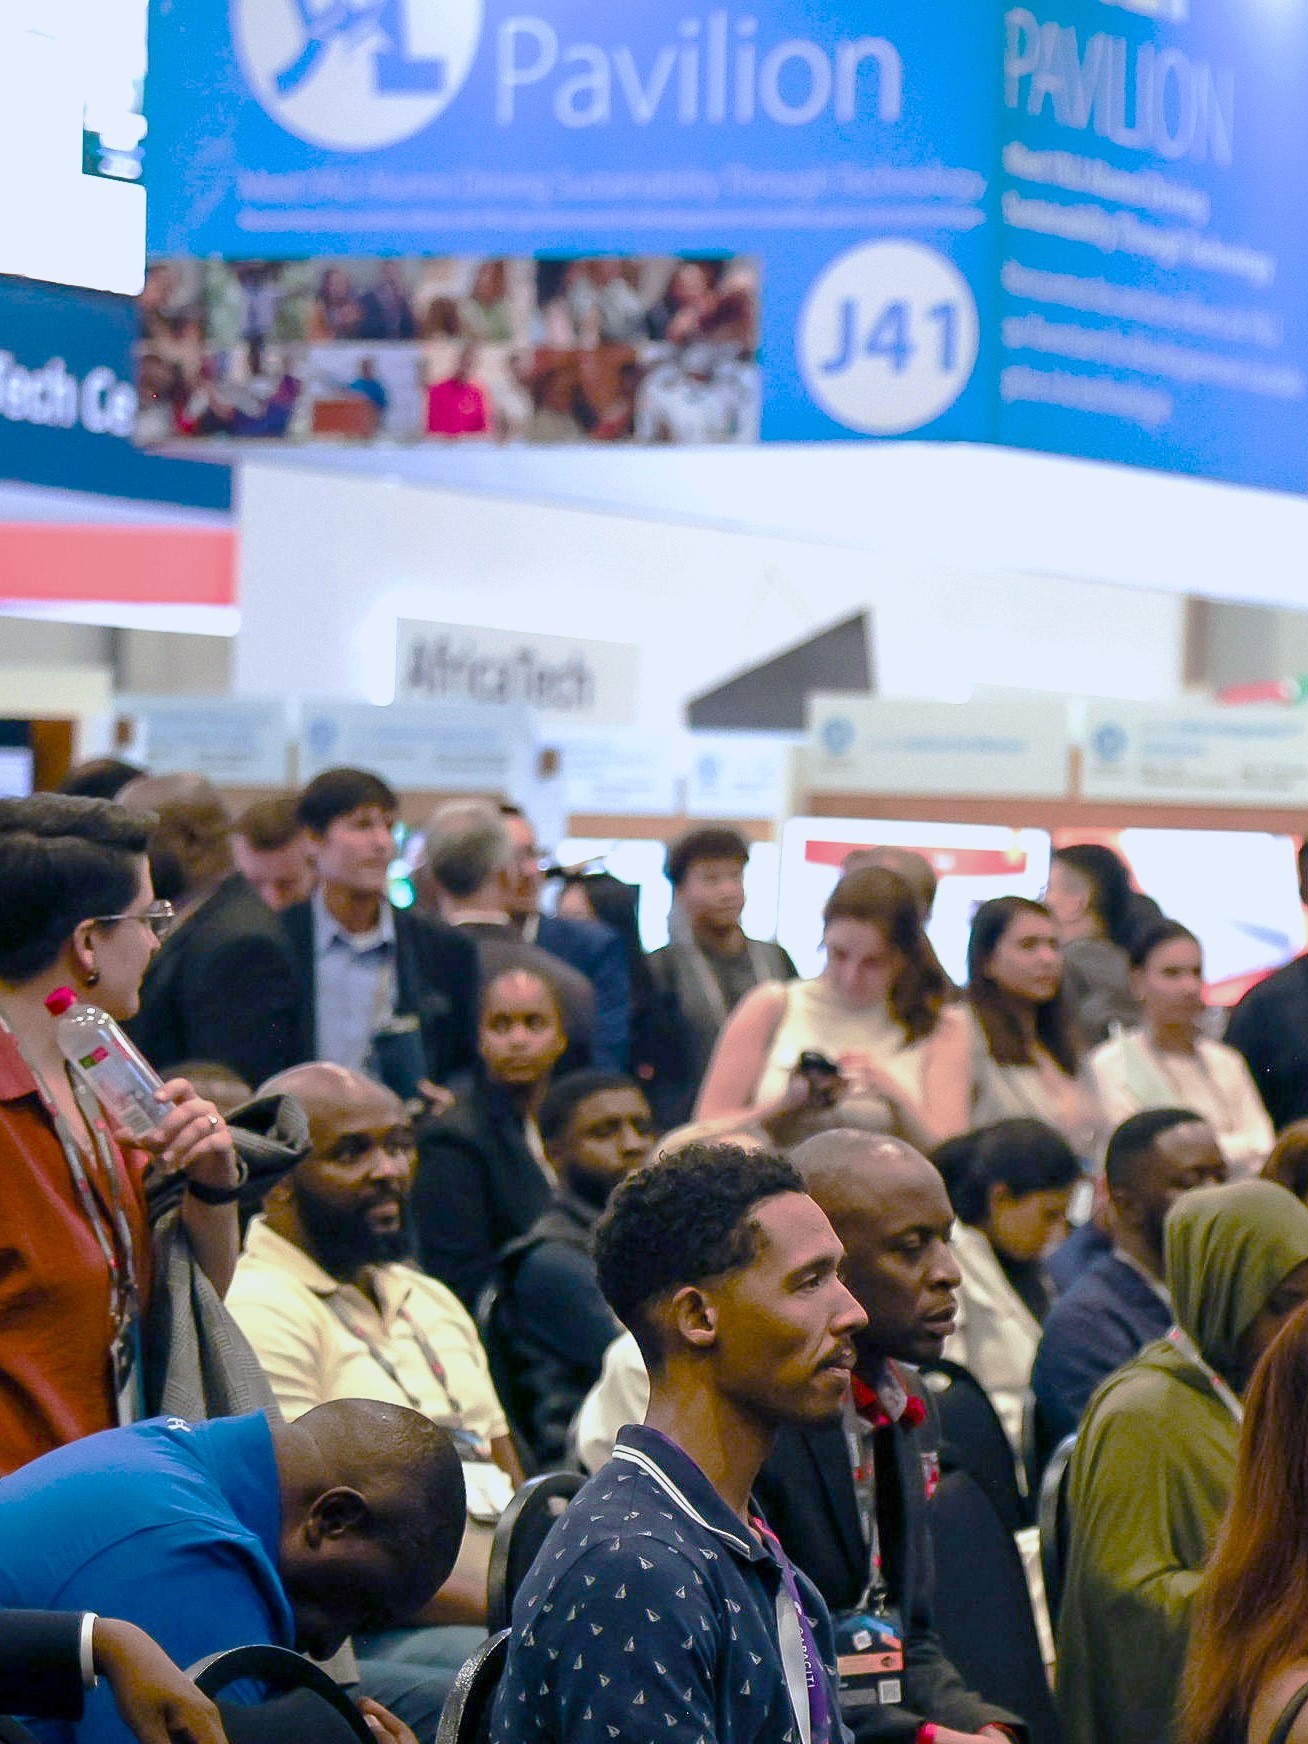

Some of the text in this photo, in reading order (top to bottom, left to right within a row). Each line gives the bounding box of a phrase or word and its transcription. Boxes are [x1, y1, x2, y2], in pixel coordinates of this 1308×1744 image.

[495, 9, 903, 128] Pavilion
[1003, 7, 1236, 168] PAVILION
[821, 298, 960, 376] J41
